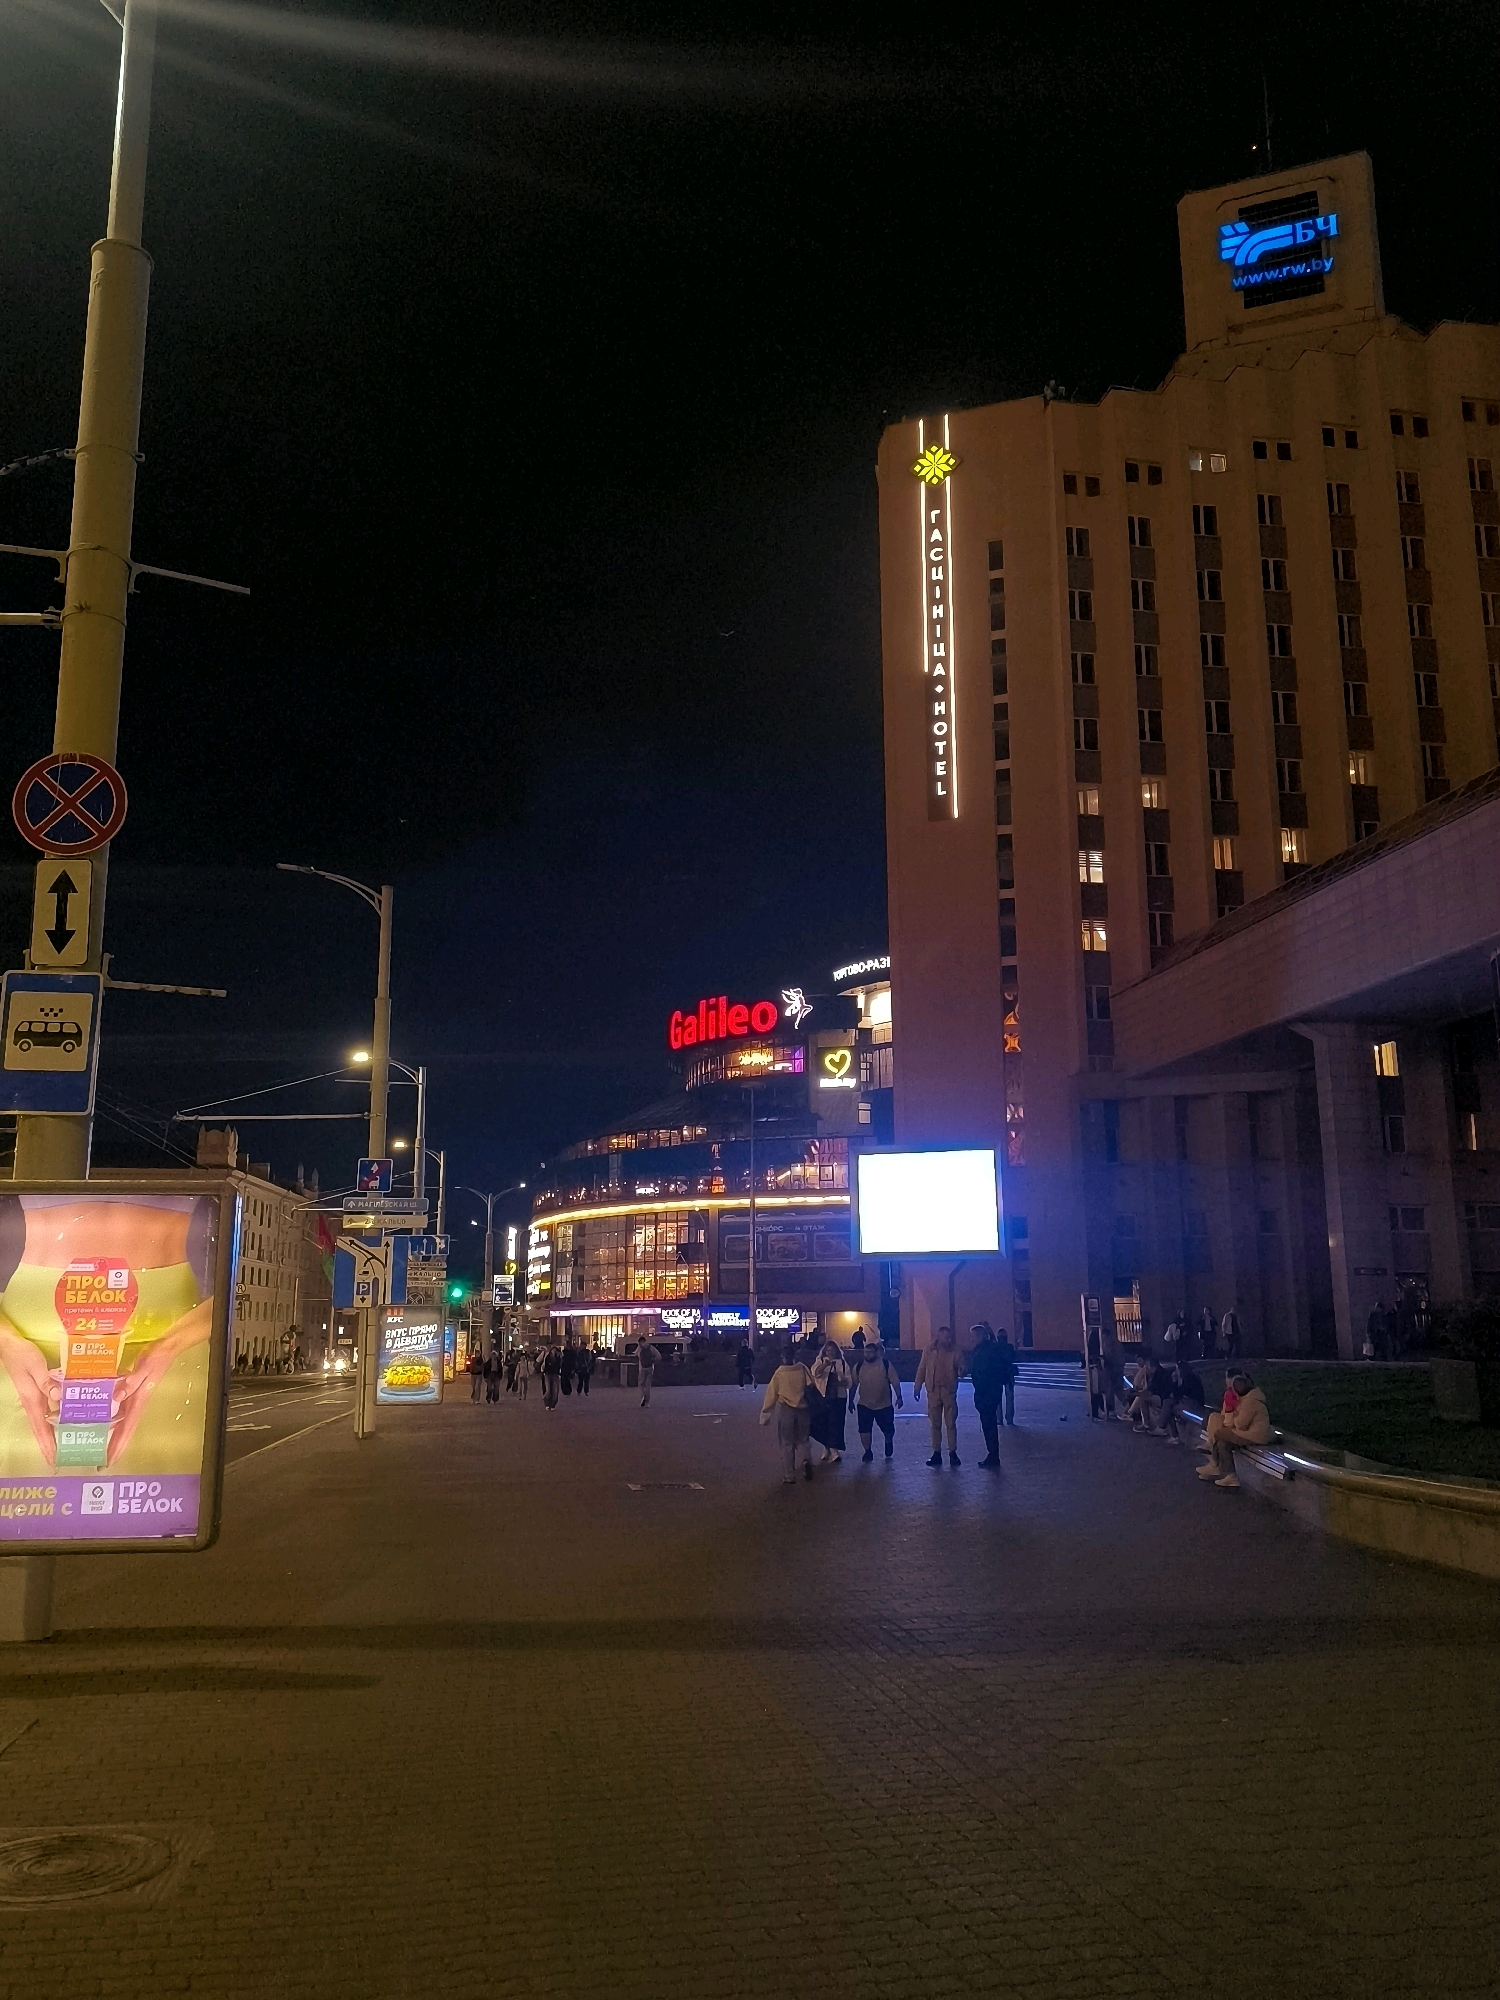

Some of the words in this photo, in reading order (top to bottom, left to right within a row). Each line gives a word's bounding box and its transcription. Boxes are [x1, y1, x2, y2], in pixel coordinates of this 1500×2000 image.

[1294, 213, 1339, 244] БЧ
[1232, 257, 1334, 287] www.rw.by
[930, 509, 946, 677] ГАСЦІНІЦА
[932, 701, 948, 796] HOTEL
[670, 996, 778, 1050] Galileo
[67, 1275, 107, 1289] ПРО
[65, 1290, 127, 1304] БЕЛОК
[75, 1318, 97, 1331] 24
[386, 1339, 393, 1348] В
[118, 1481, 162, 1498] ПРО
[1, 1503, 55, 1519] цели
[61, 1502, 74, 1515] с
[117, 1498, 184, 1514] БЕЛОК
